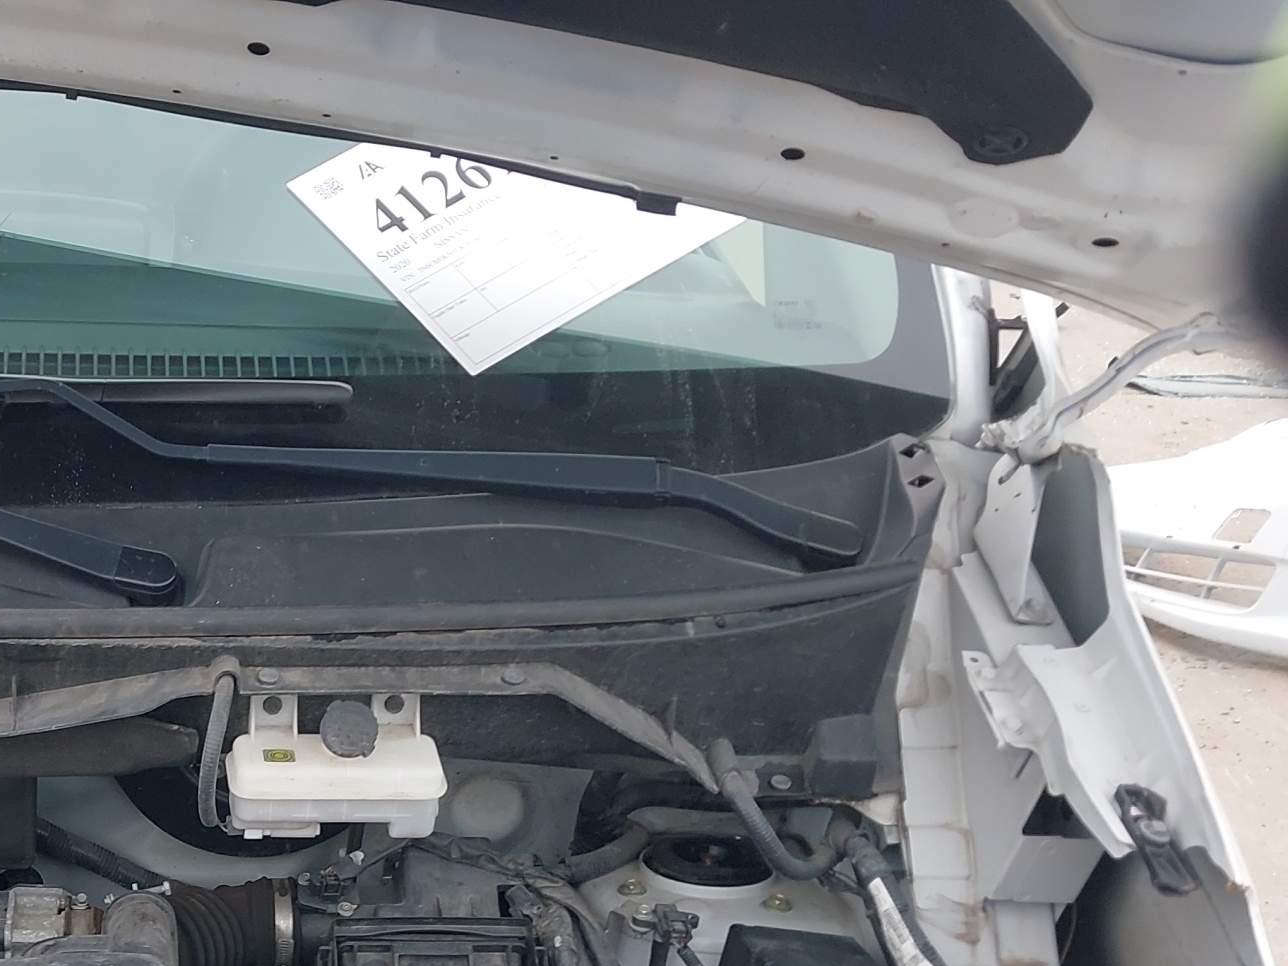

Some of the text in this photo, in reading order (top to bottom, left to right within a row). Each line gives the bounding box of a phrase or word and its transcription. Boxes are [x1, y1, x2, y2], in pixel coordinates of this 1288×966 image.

[375, 158, 511, 232] 4126
[376, 241, 410, 262] State
[409, 223, 444, 244] Farm
